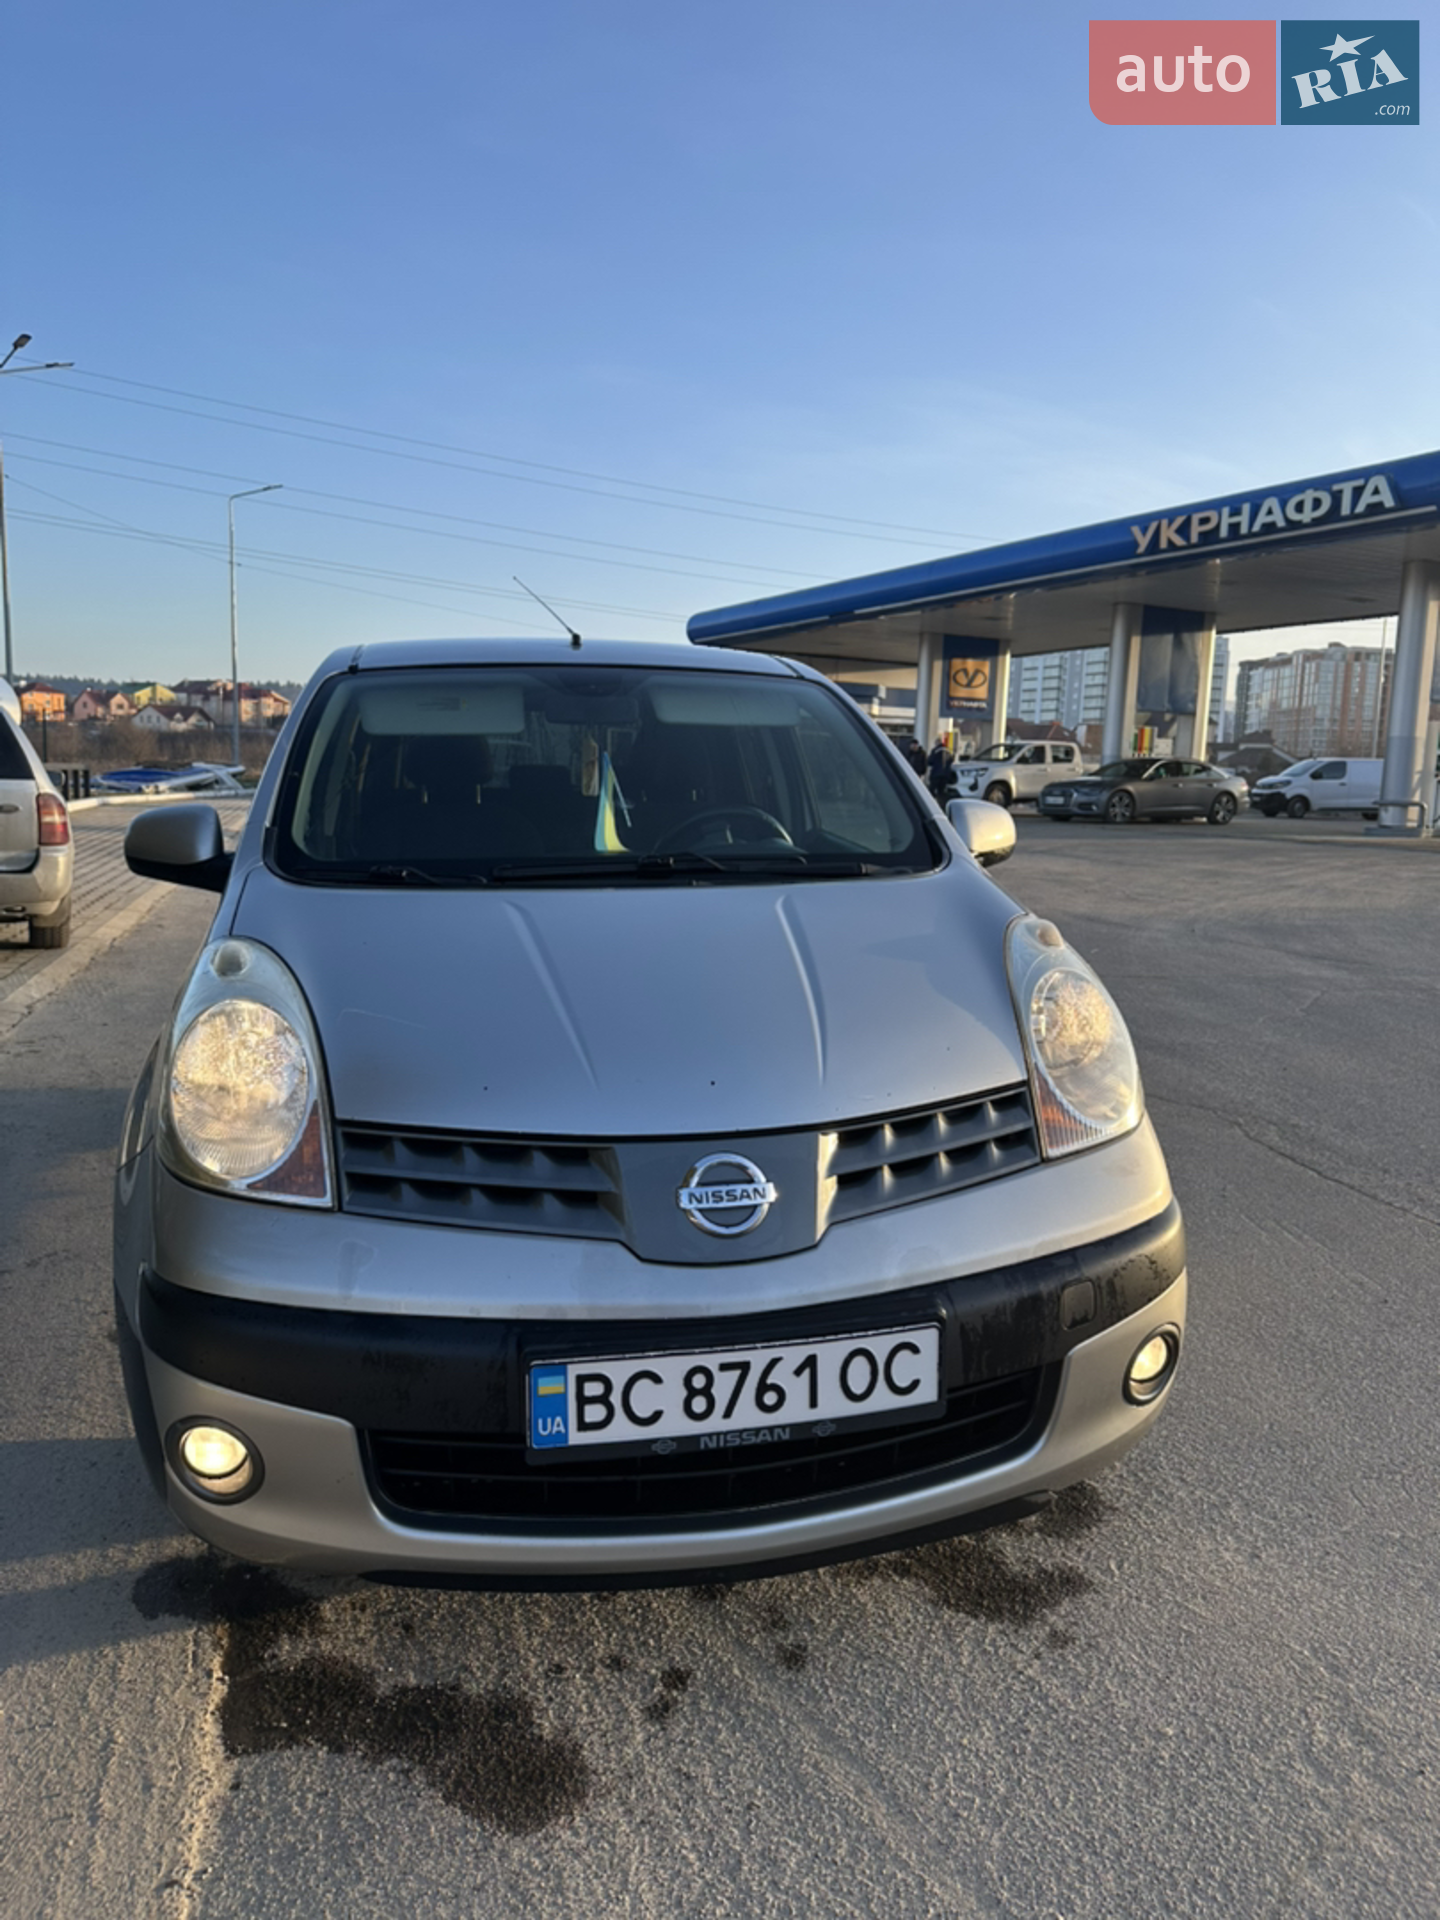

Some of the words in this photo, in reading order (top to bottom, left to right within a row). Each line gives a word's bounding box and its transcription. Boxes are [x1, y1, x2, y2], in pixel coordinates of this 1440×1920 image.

[1130, 474, 1396, 554] УКРНАФТА
[688, 1187, 767, 1204] NISSAN
[575, 1370, 665, 1433] BC
[682, 1355, 819, 1422] 8761
[839, 1341, 922, 1402] OC
[537, 1416, 566, 1437] UA
[701, 1427, 791, 1449] NISSAN
